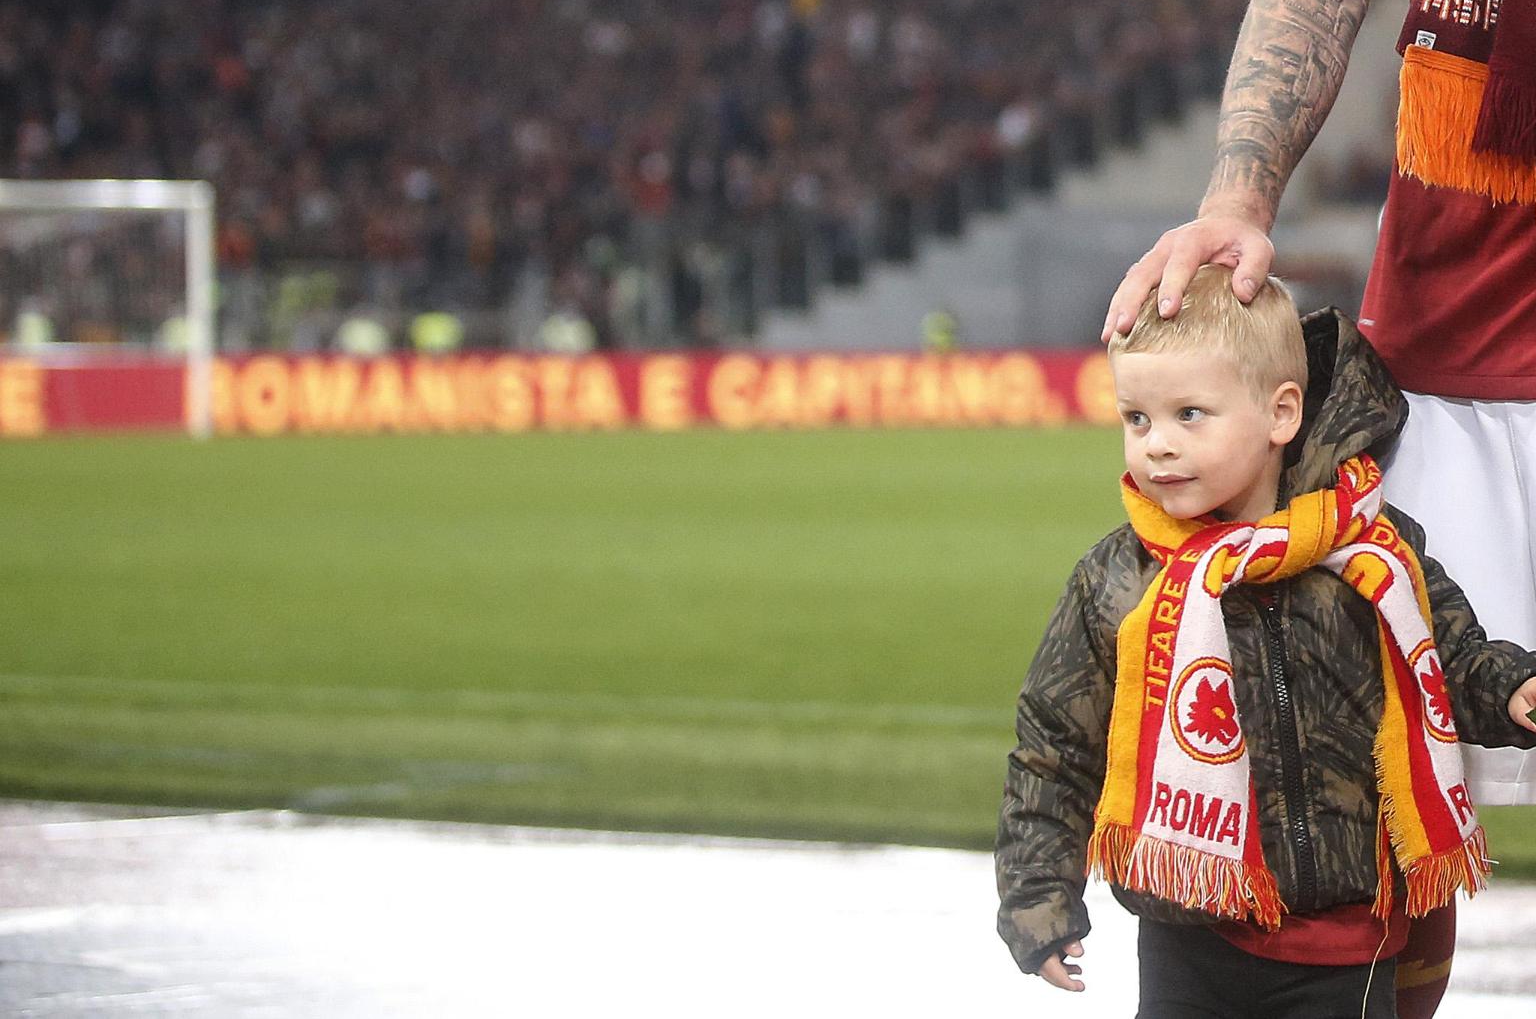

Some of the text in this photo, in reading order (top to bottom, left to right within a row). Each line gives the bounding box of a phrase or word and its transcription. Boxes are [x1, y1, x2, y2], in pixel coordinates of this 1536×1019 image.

[640, 353, 692, 431] E
[1144, 576, 1187, 711] TIFARE
[1149, 781, 1242, 847] ROMA
